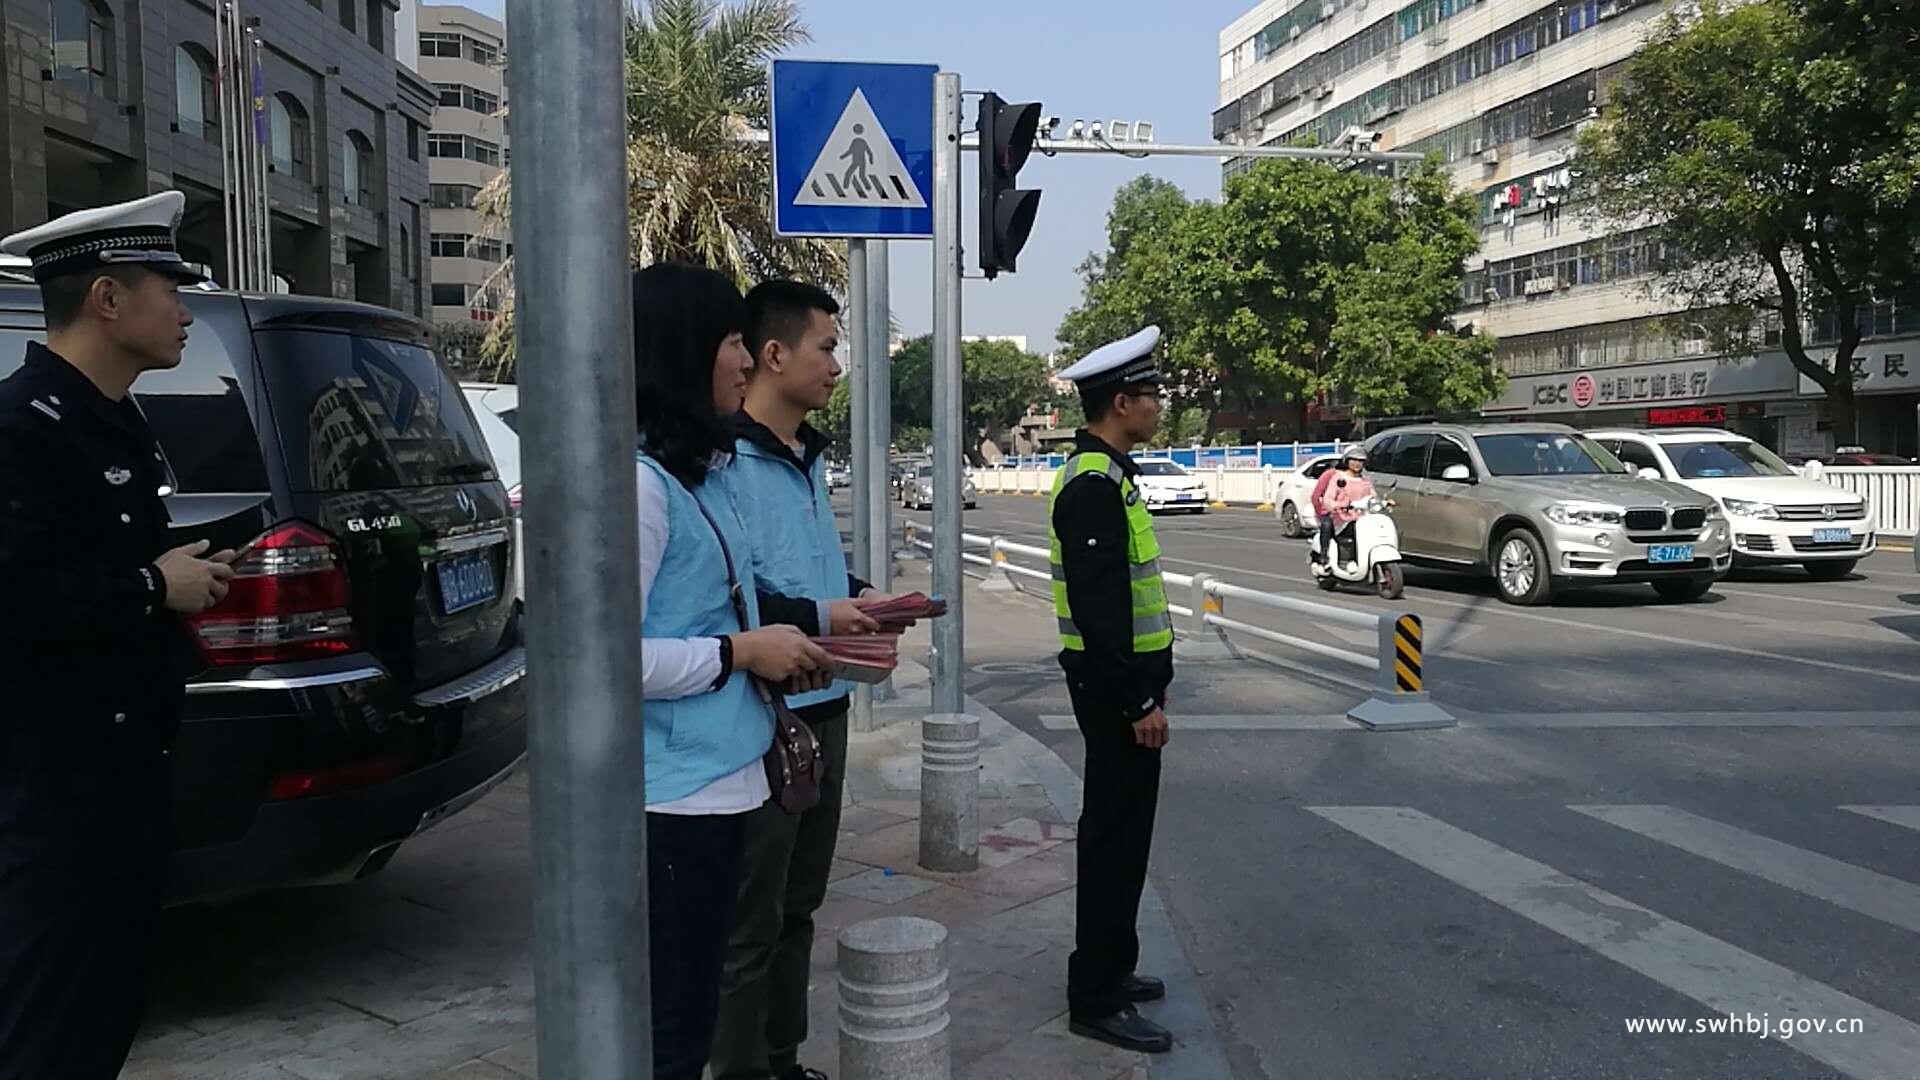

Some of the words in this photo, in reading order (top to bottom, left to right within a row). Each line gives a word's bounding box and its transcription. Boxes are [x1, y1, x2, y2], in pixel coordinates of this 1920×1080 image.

[1822, 353, 1909, 379] 区民
[1532, 383, 1568, 405] ICBC
[347, 518, 370, 532] GL
